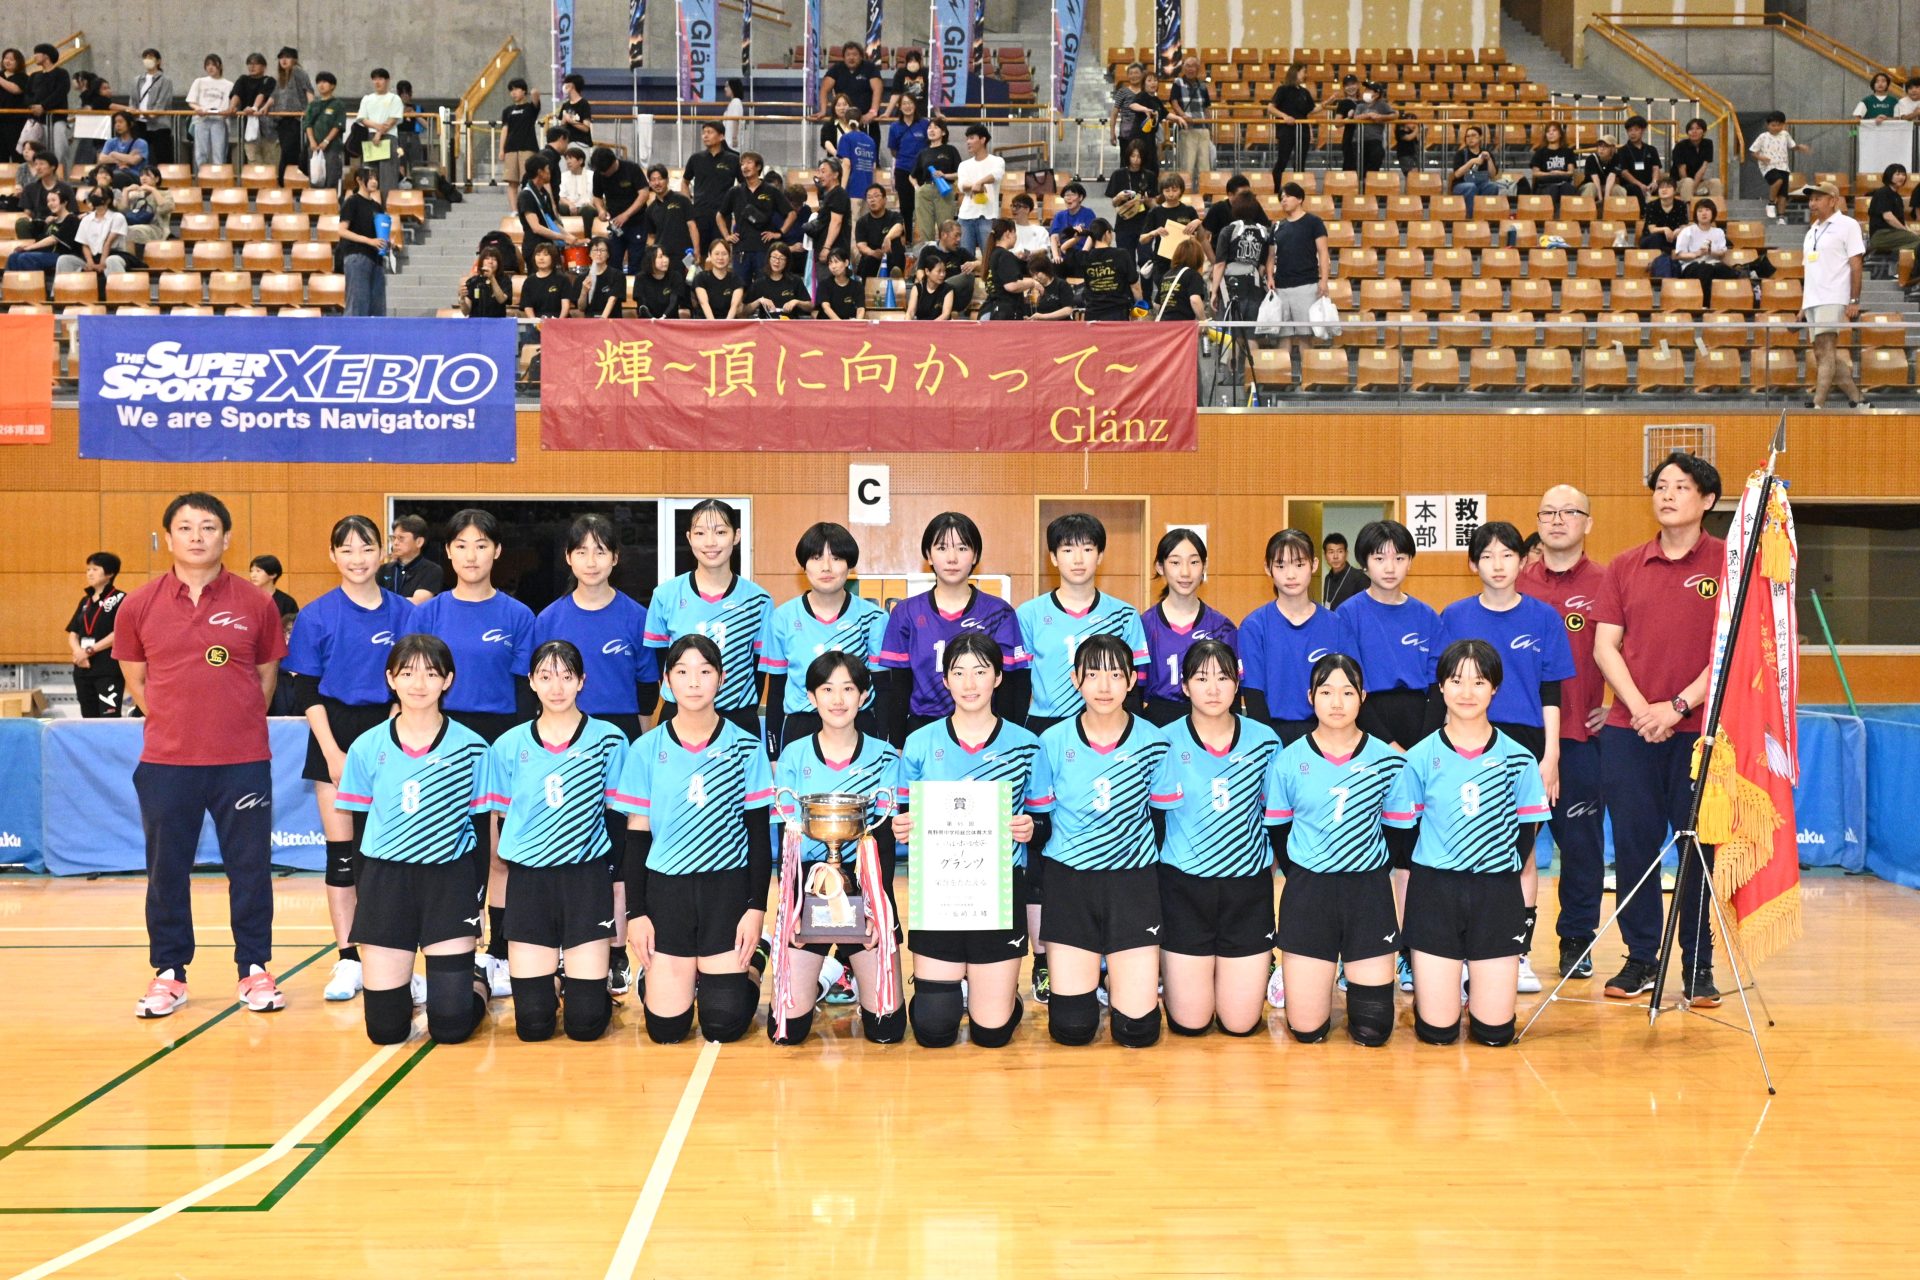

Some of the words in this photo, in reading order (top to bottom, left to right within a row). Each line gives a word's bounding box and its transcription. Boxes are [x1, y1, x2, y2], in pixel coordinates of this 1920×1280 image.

[558, 13, 571, 80] Glän
[691, 19, 712, 99] Glänz
[943, 26, 966, 104] Glänz
[115, 352, 146, 365] THE
[140, 340, 271, 379] SUPER
[256, 345, 499, 406] XEBIO
[98, 363, 256, 402] SPORTS
[116, 404, 158, 428] We
[167, 411, 212, 429] are
[221, 406, 311, 432] Sports
[320, 408, 476, 434] Navigators!
[1049, 405, 1169, 445] Glänz
[857, 479, 881, 506] C
[1415, 500, 1437, 548] 本部
[1701, 581, 1714, 596] M
[1567, 616, 1581, 628] C
[401, 780, 420, 814] 8
[545, 773, 564, 809] 6
[686, 774, 707, 809] 4
[1092, 777, 1111, 813] 3
[1211, 778, 1231, 813] 5
[1329, 787, 1349, 823] 7
[1460, 781, 1480, 817] 9
